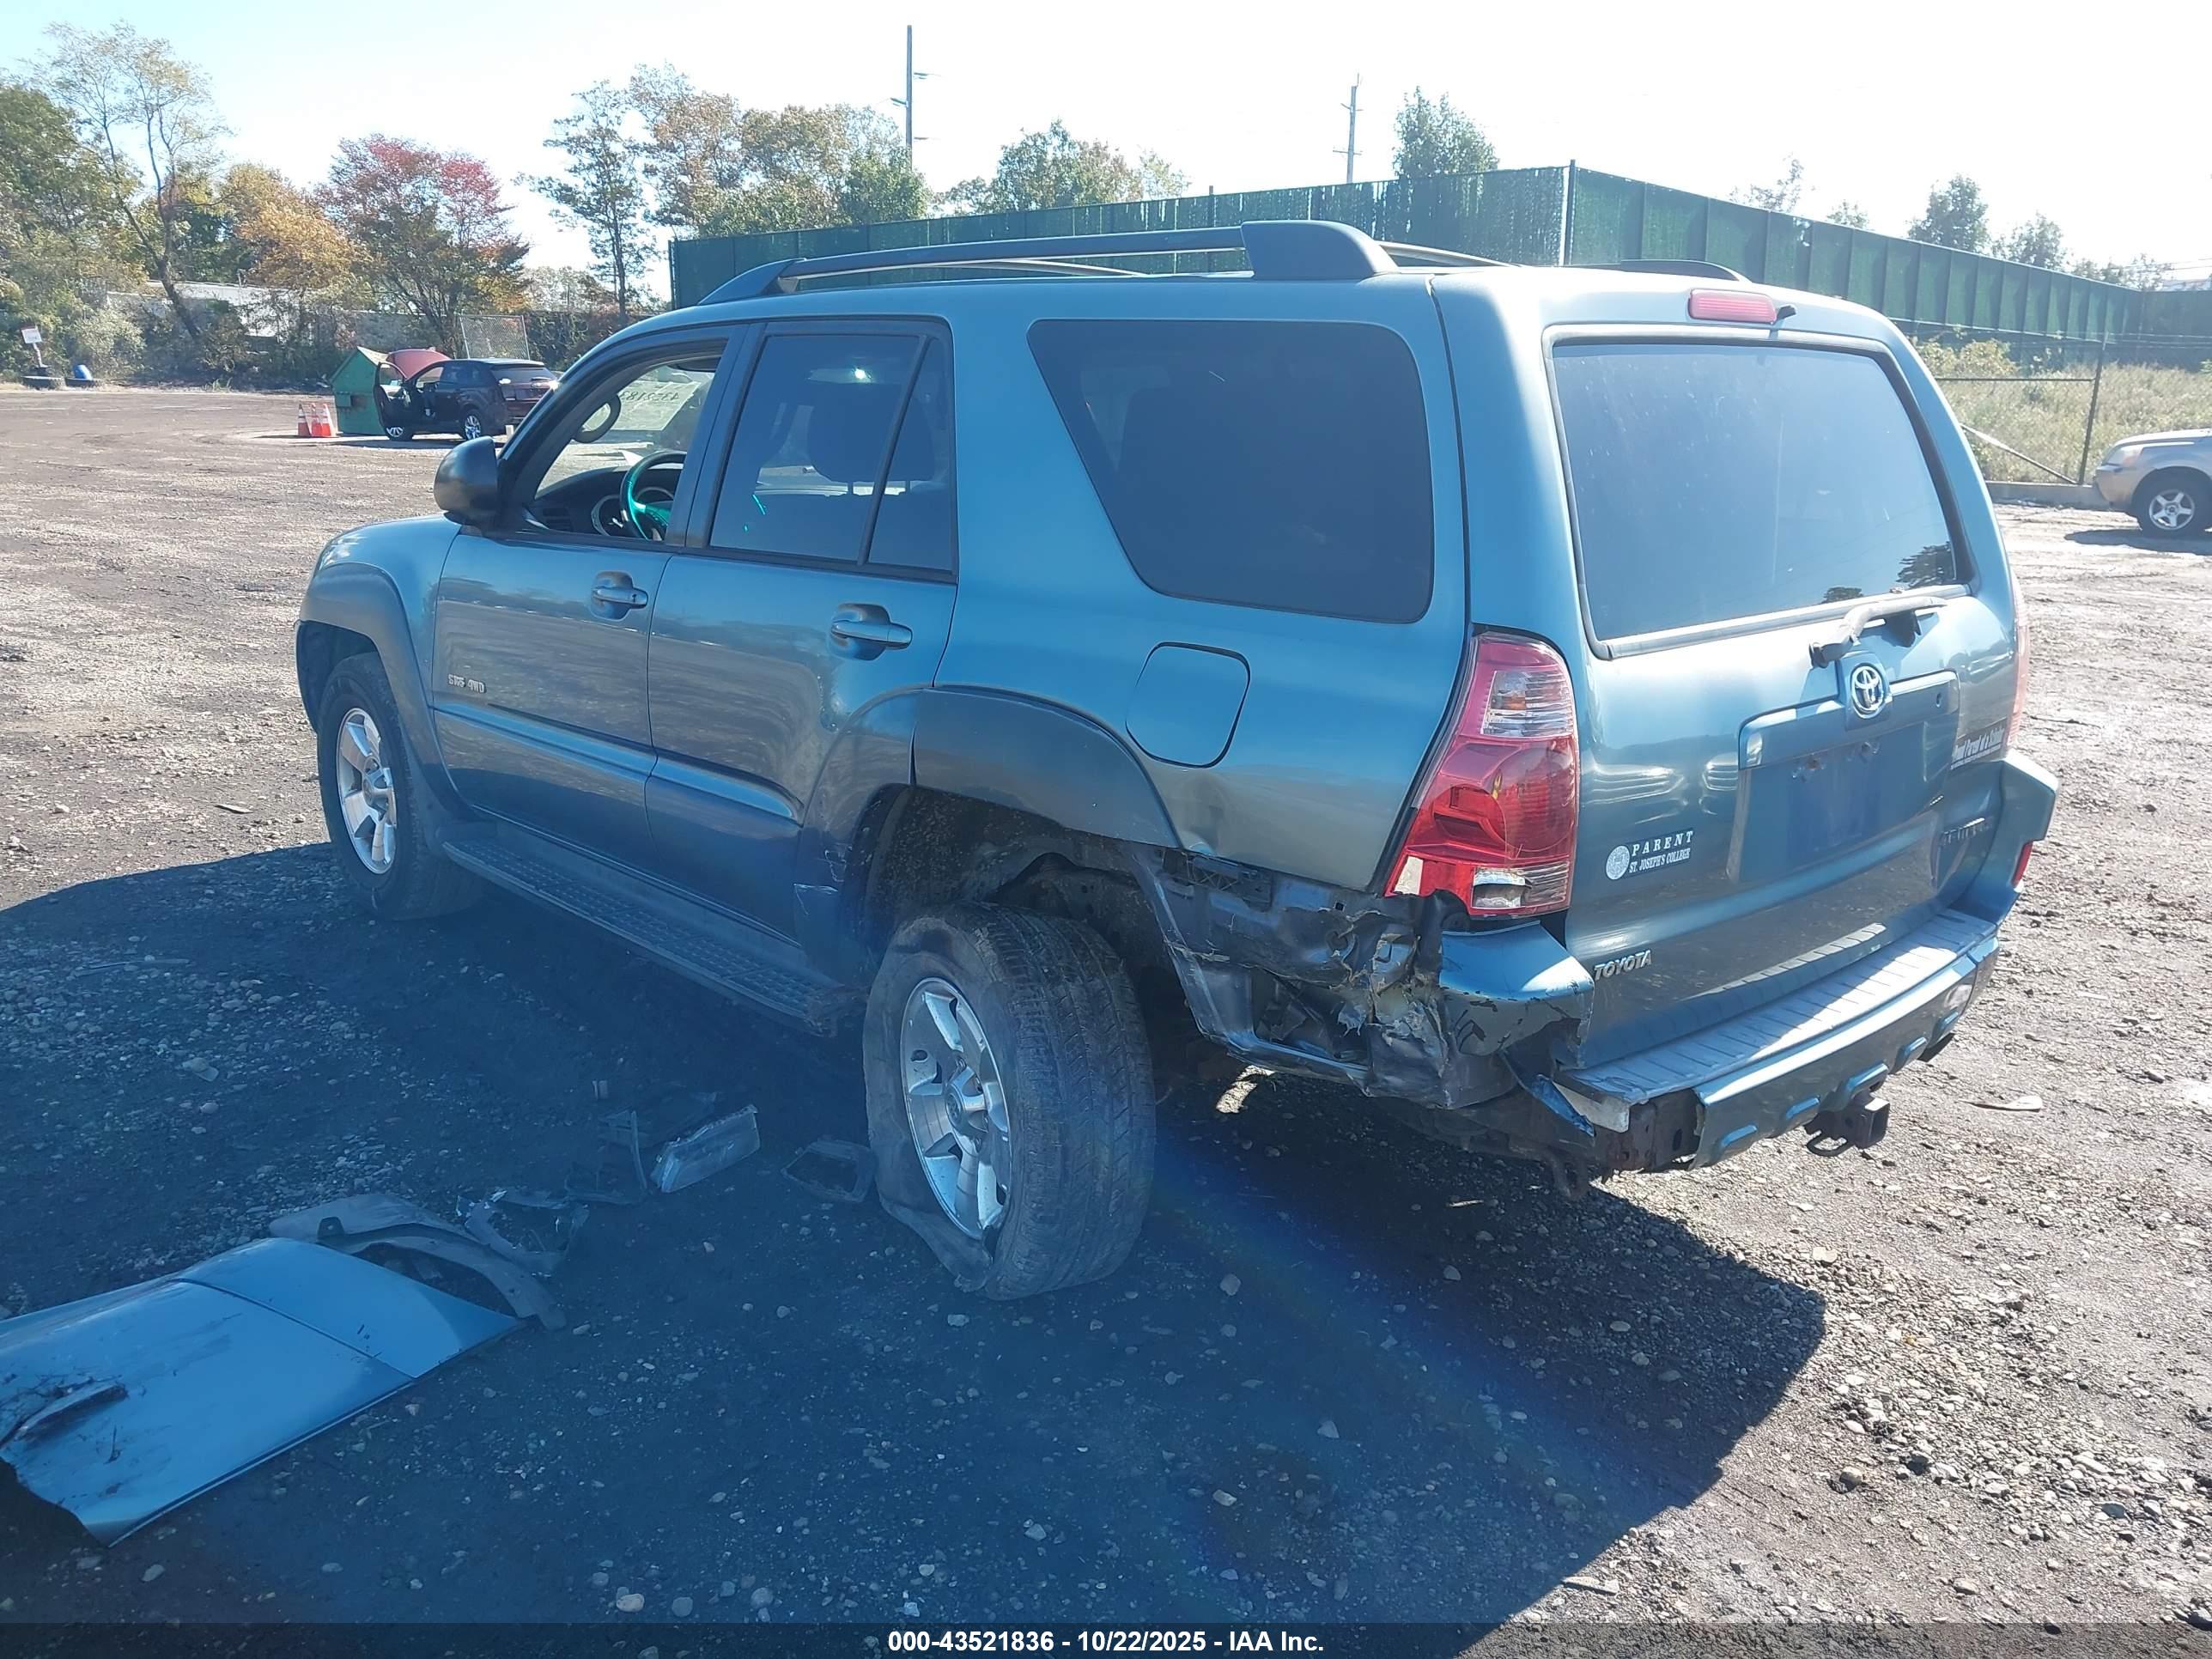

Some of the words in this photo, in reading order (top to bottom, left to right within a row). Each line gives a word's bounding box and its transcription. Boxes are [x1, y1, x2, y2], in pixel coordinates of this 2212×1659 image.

[1632, 830, 1693, 857] PARENT
[1629, 861, 1638, 873] ST.
[1638, 854, 1666, 872] JOSEPH'S
[1666, 848, 1691, 865] COLLEGE
[1594, 949, 1652, 981] TOYOTA
